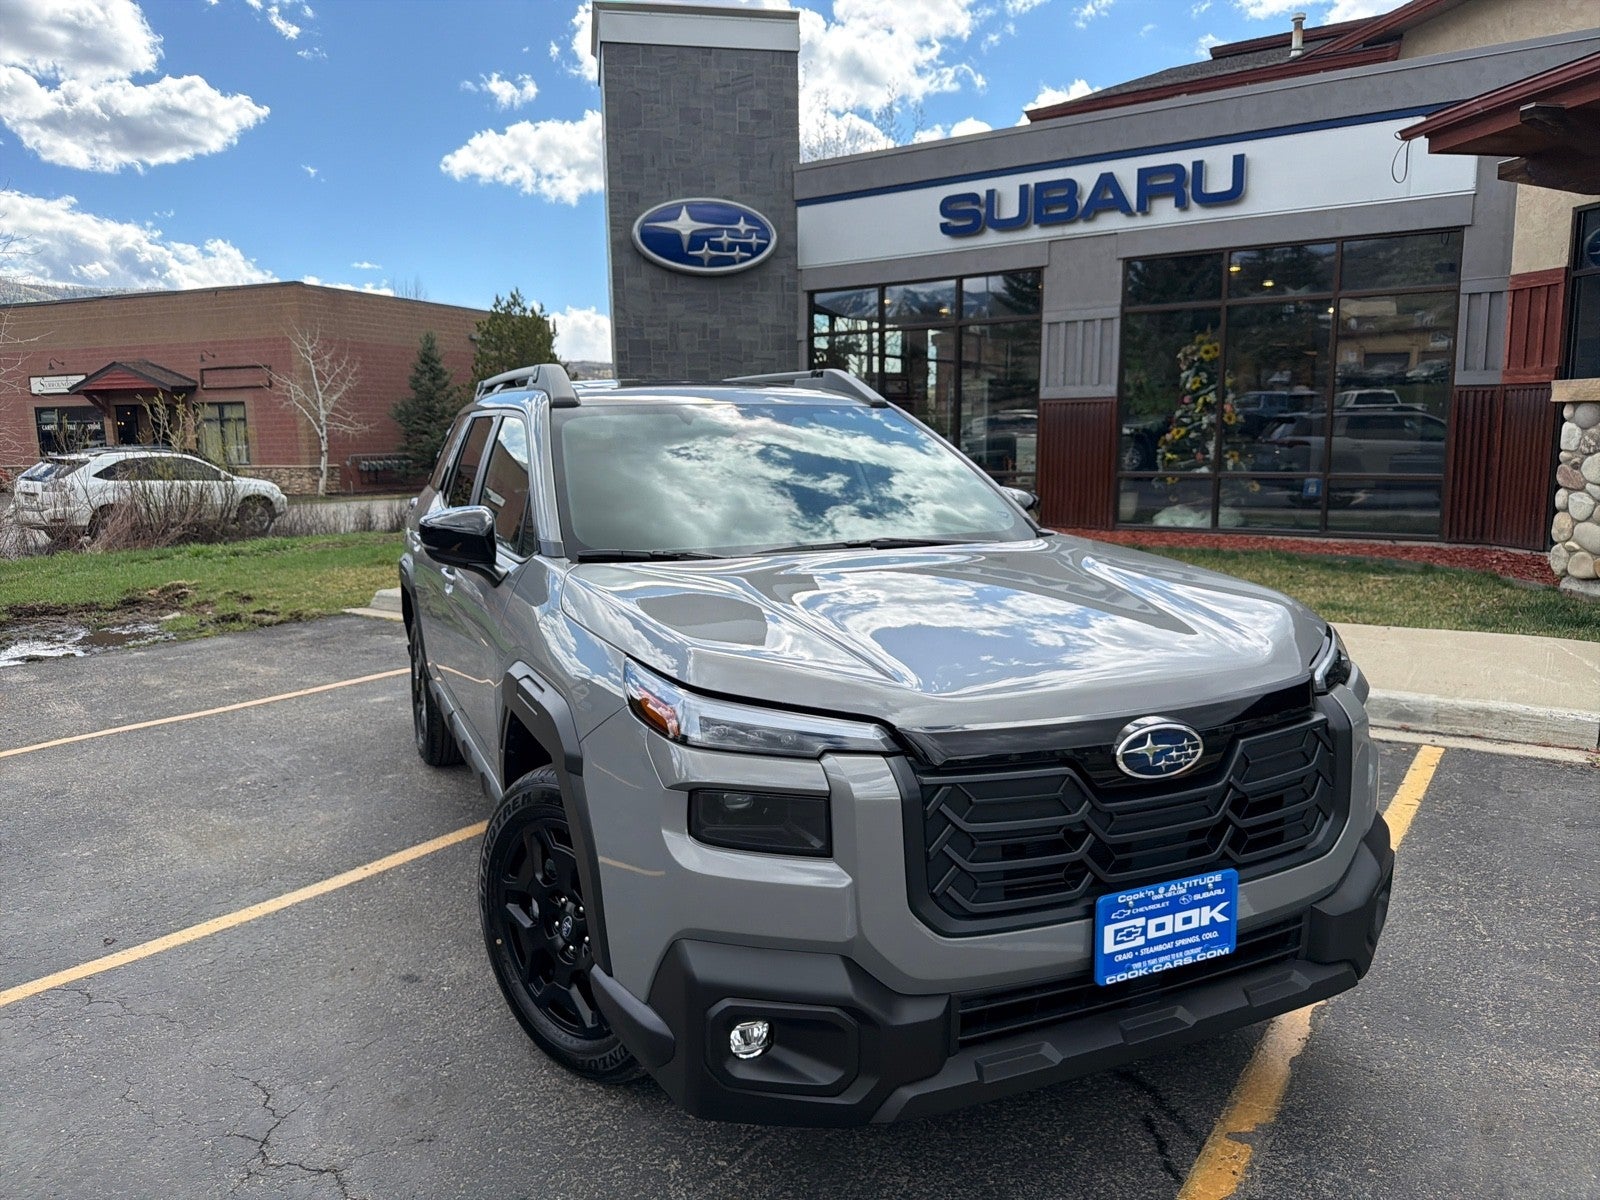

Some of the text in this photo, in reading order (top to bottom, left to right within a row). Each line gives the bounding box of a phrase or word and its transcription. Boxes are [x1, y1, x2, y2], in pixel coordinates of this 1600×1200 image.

[939, 153, 1246, 237] SUBARU
[1117, 890, 1154, 904] Cook'n
[1168, 874, 1223, 891] ALTITUDE
[1193, 888, 1225, 901] SUBARU
[1131, 901, 1170, 914] CHEVROLET
[1103, 901, 1230, 954] COOK
[1114, 951, 1134, 963] CRAIG
[1139, 942, 1174, 956] STEAMBOAT
[1201, 930, 1219, 942] COLO.
